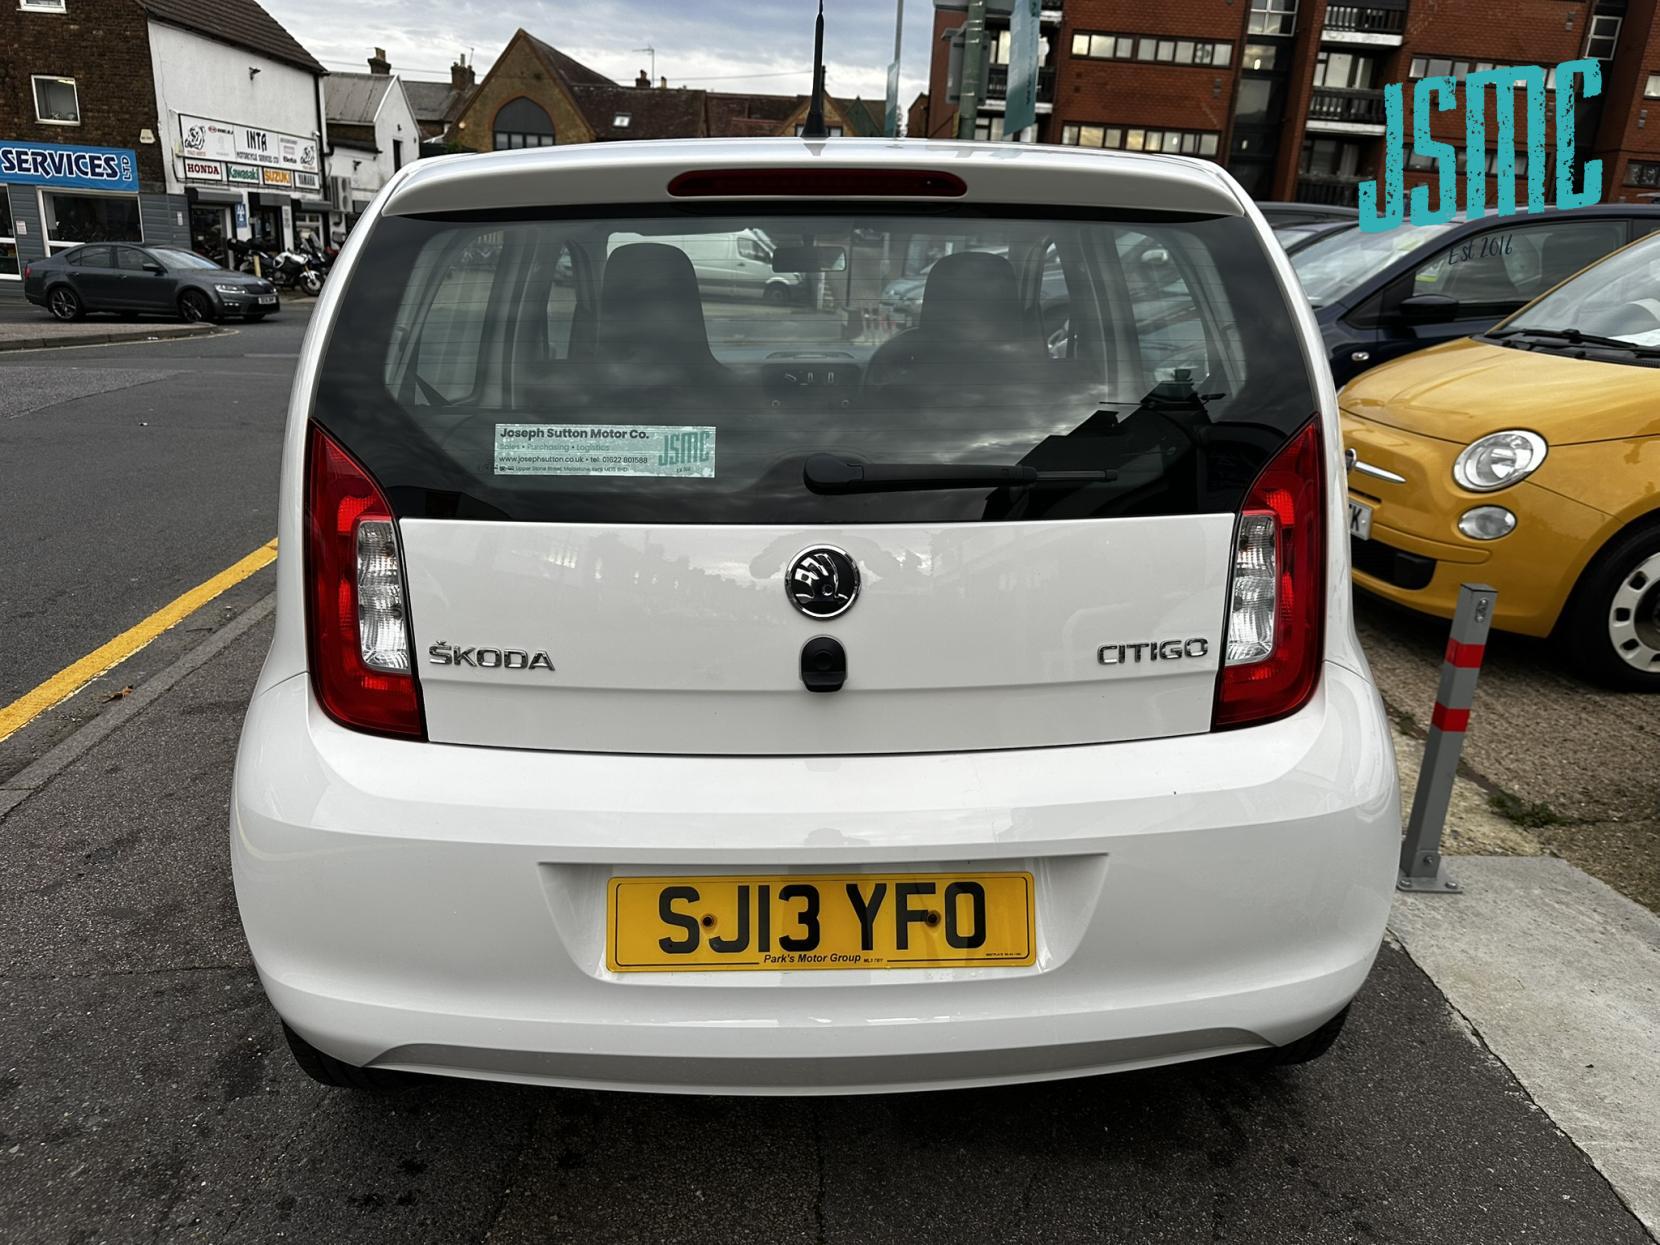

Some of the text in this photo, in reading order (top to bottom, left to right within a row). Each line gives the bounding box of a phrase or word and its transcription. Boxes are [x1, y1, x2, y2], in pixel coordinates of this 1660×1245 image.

[246, 130, 268, 152] INTA
[1, 148, 132, 181] SERVICES LTD
[187, 163, 220, 175] HONDA
[228, 165, 260, 180] Kawasaki
[264, 168, 291, 184] SUZUKI
[500, 428, 650, 441] Joseph Sutton Motor Co.
[658, 431, 710, 467] JSMC
[429, 640, 555, 671] ŠKODA
[1097, 638, 1208, 665] CITIGO
[658, 881, 986, 954] SJ13 YFO
[764, 954, 795, 964] Park's
[797, 954, 829, 964] Motor
[829, 953, 861, 964] Group
